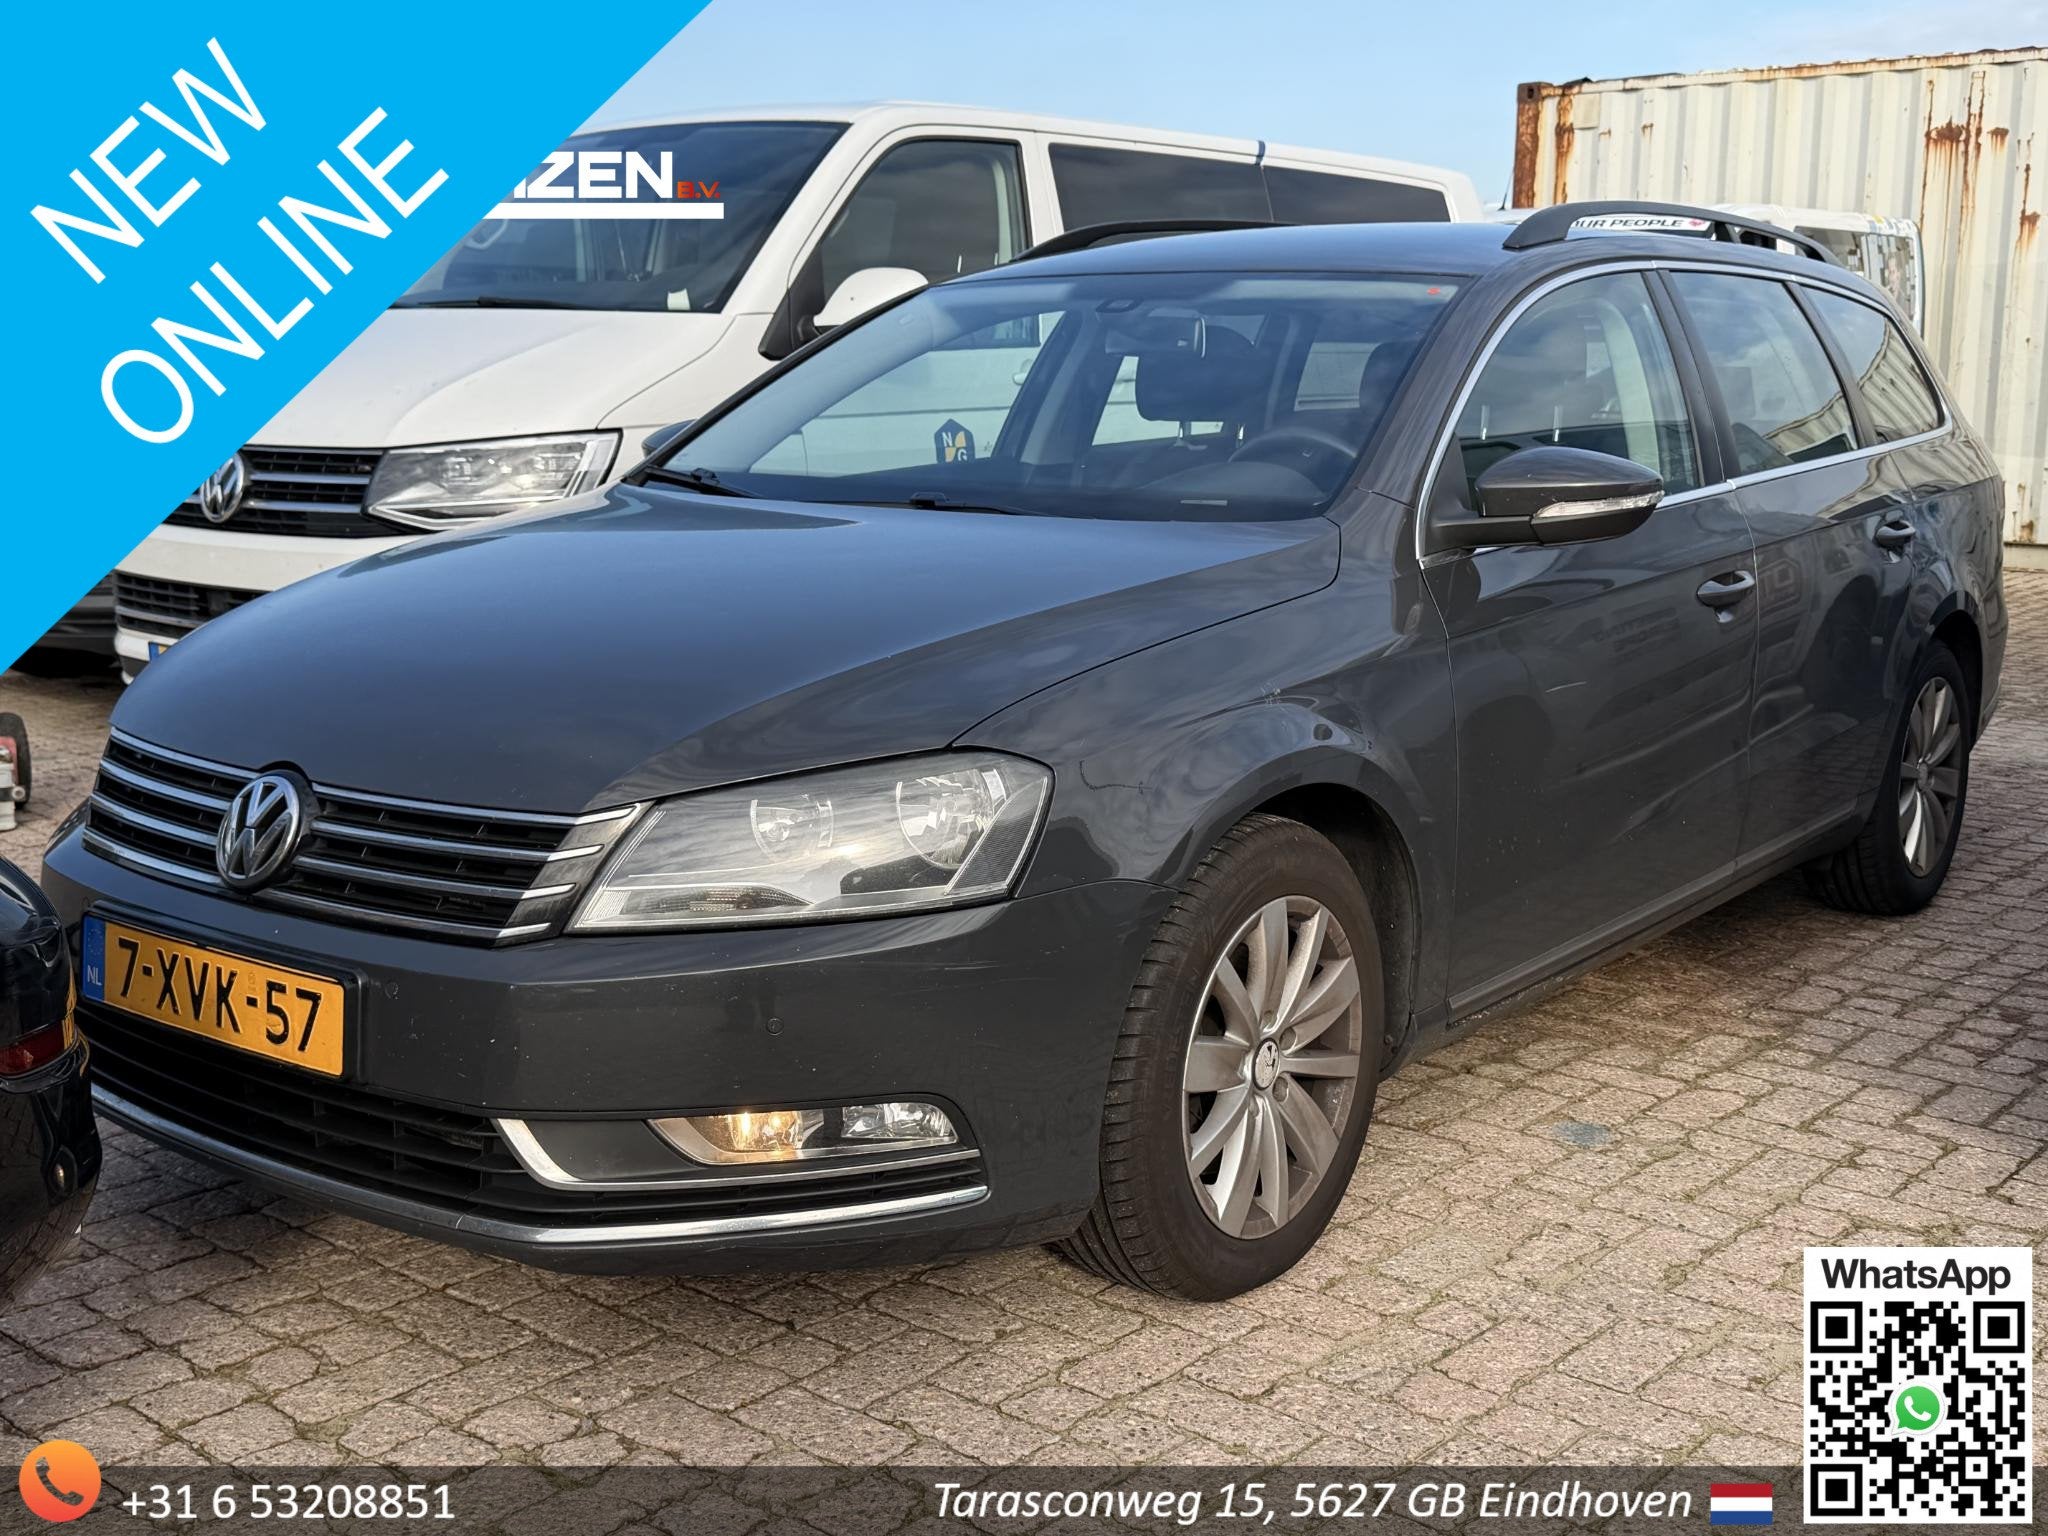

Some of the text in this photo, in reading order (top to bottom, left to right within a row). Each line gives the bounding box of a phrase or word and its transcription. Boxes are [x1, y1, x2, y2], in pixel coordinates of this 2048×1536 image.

[1609, 218, 1684, 228] PEOPLE
[87, 936, 322, 1053] NL 7-XVK-57
